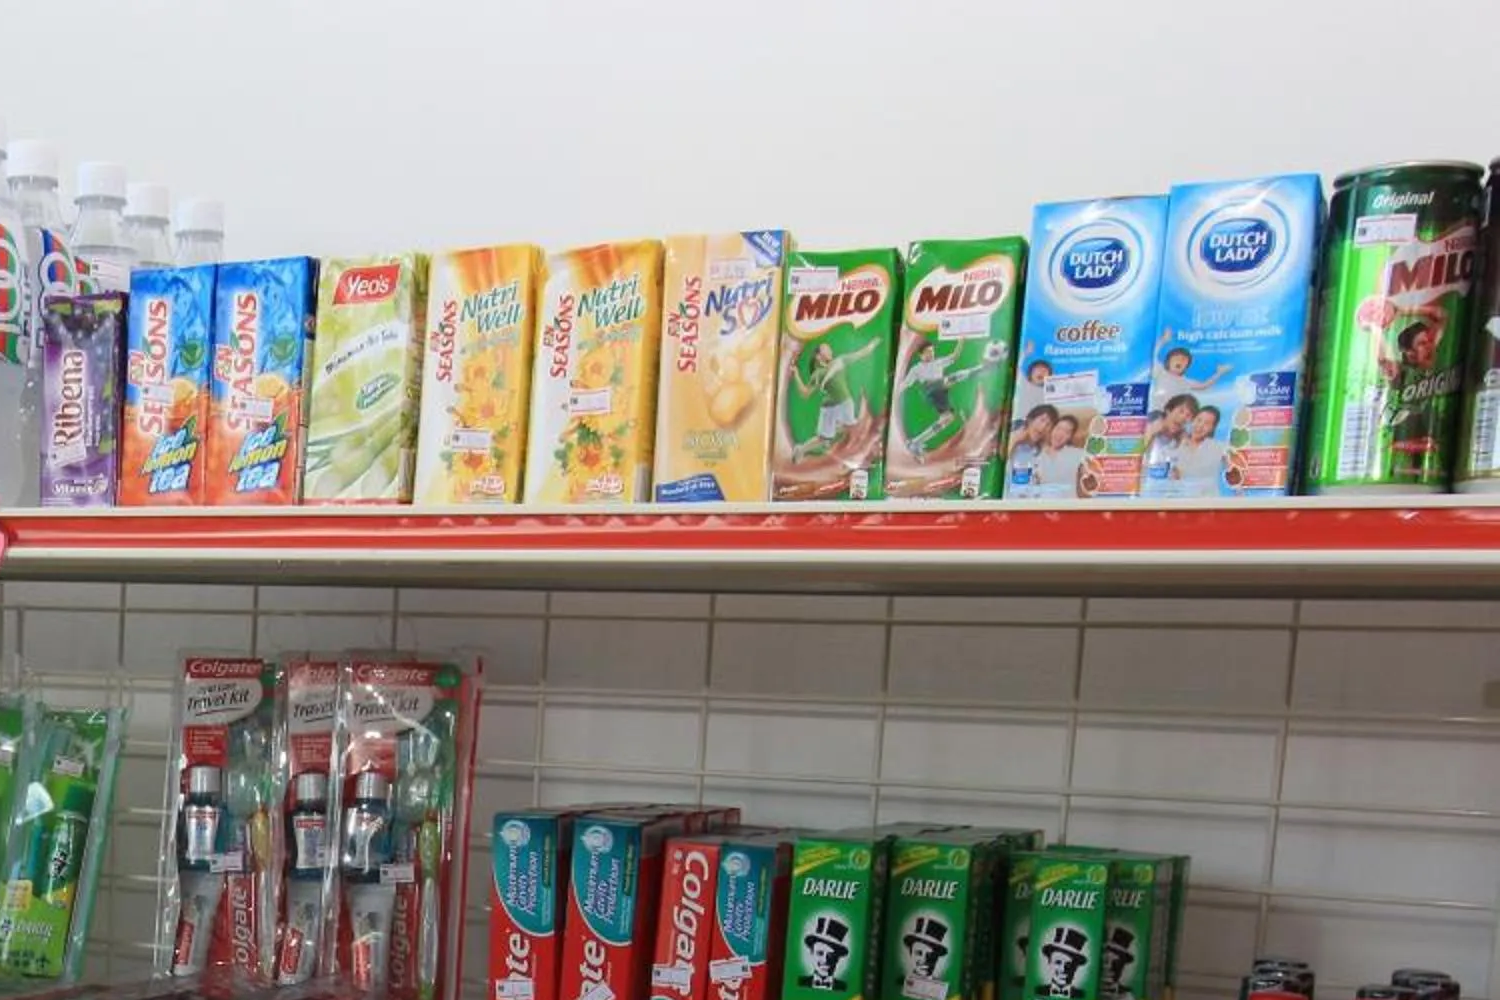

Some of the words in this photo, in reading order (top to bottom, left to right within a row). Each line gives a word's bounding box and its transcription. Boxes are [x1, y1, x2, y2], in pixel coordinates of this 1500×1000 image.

[1373, 191, 1435, 209] Original
[1210, 229, 1268, 248] DUTCH
[1070, 249, 1124, 267] DUTCH
[1215, 245, 1260, 263] LADY
[347, 274, 390, 297] Yeo's
[1074, 264, 1115, 281] LADY
[1389, 252, 1474, 294] MILO
[459, 280, 519, 323] Nutri
[577, 275, 639, 318] Nutri
[704, 273, 775, 317] Nutri
[795, 288, 881, 321] MILO
[915, 280, 1004, 314] MILO
[476, 303, 522, 334] Well
[595, 297, 643, 329] Well
[678, 275, 702, 374] SEASONS
[436, 299, 458, 382] SEASONS
[550, 294, 576, 379] SEASONS
[1056, 320, 1121, 343] coffee
[52, 348, 84, 449] Ribena
[149, 463, 192, 493] tea
[236, 461, 281, 492] tea
[188, 661, 264, 679] Colgate
[187, 692, 229, 712] Travel
[231, 688, 250, 705] Kit
[803, 877, 861, 900] DARLIE
[901, 877, 959, 899] DARLIE
[1041, 886, 1099, 910] DARLIE
